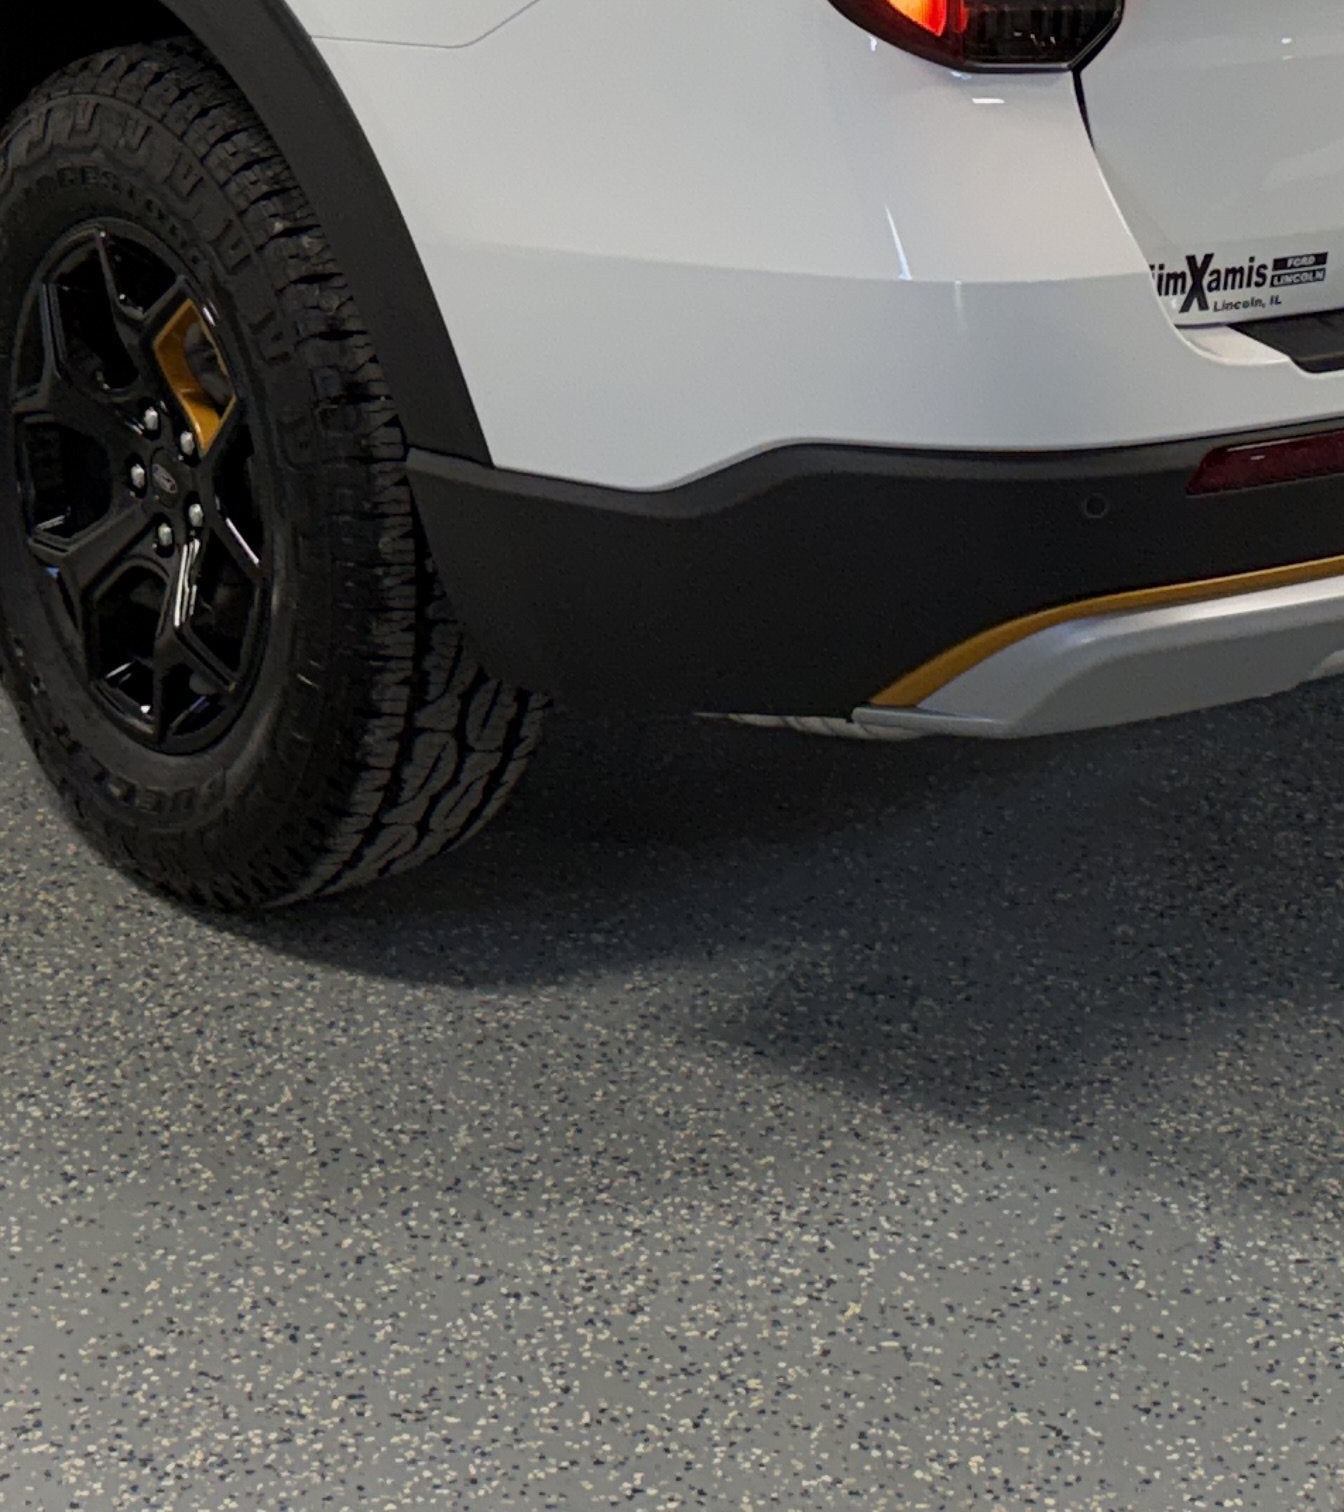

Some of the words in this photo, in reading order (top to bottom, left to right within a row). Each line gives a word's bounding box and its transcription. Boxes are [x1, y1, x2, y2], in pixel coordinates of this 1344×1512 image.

[1149, 252, 1268, 313] imXamis
[1272, 269, 1325, 287] LINCOLN
[1213, 297, 1266, 313] Lincoln,
[1269, 294, 1283, 306] IL
